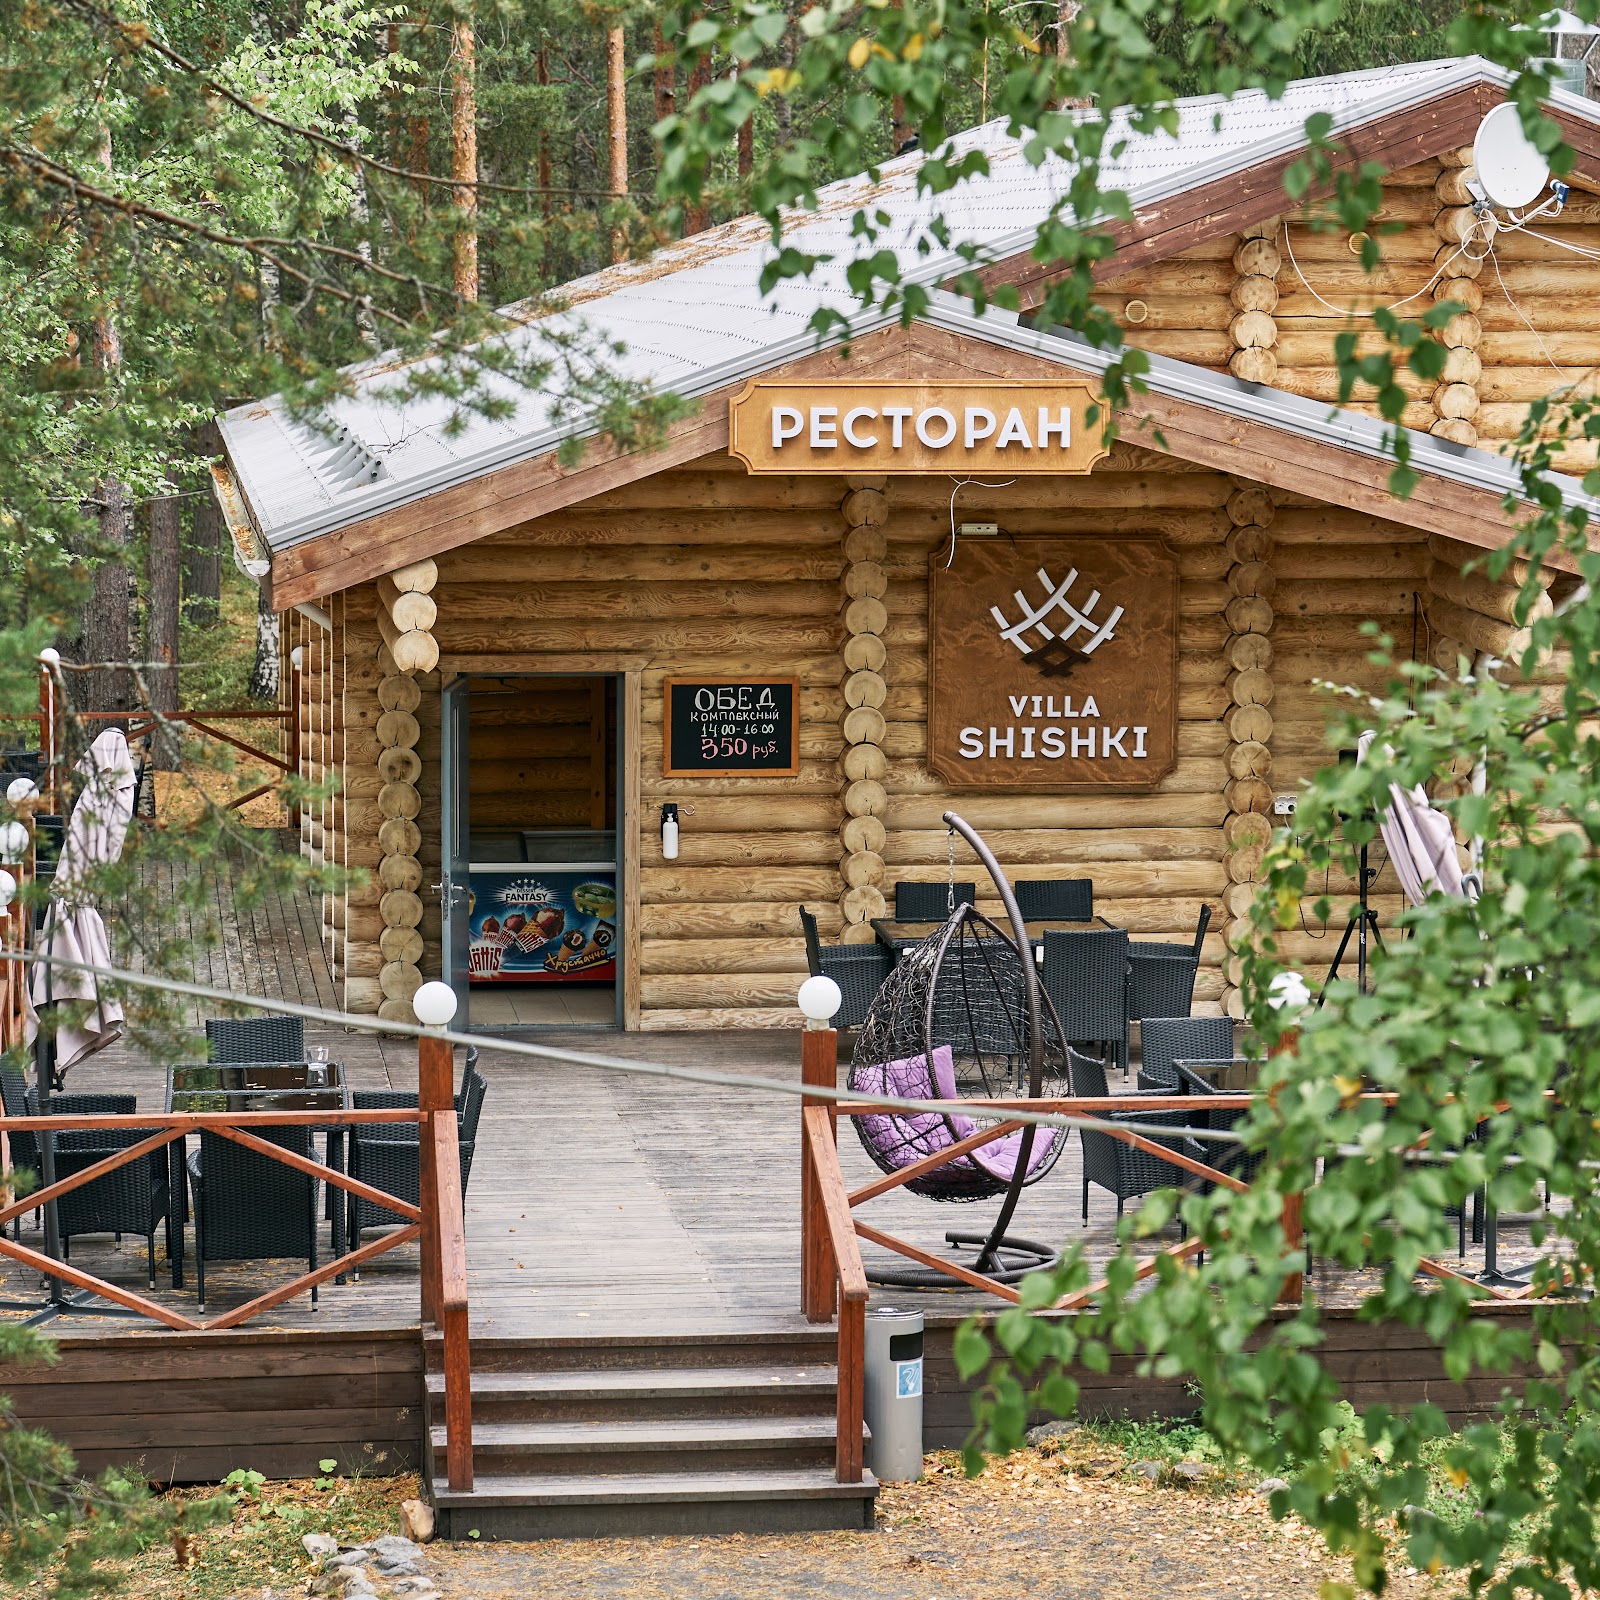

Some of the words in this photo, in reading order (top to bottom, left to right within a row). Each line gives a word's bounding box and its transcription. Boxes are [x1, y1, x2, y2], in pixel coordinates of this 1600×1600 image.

[771, 407, 1071, 449] РЕСТОРАН
[694, 687, 776, 711] ОБЕД
[1008, 695, 1100, 718] VILLA
[701, 737, 748, 760] 350
[752, 740, 779, 760] руб.
[958, 726, 1148, 759] SHISHKI
[505, 893, 548, 901] FANTASY
